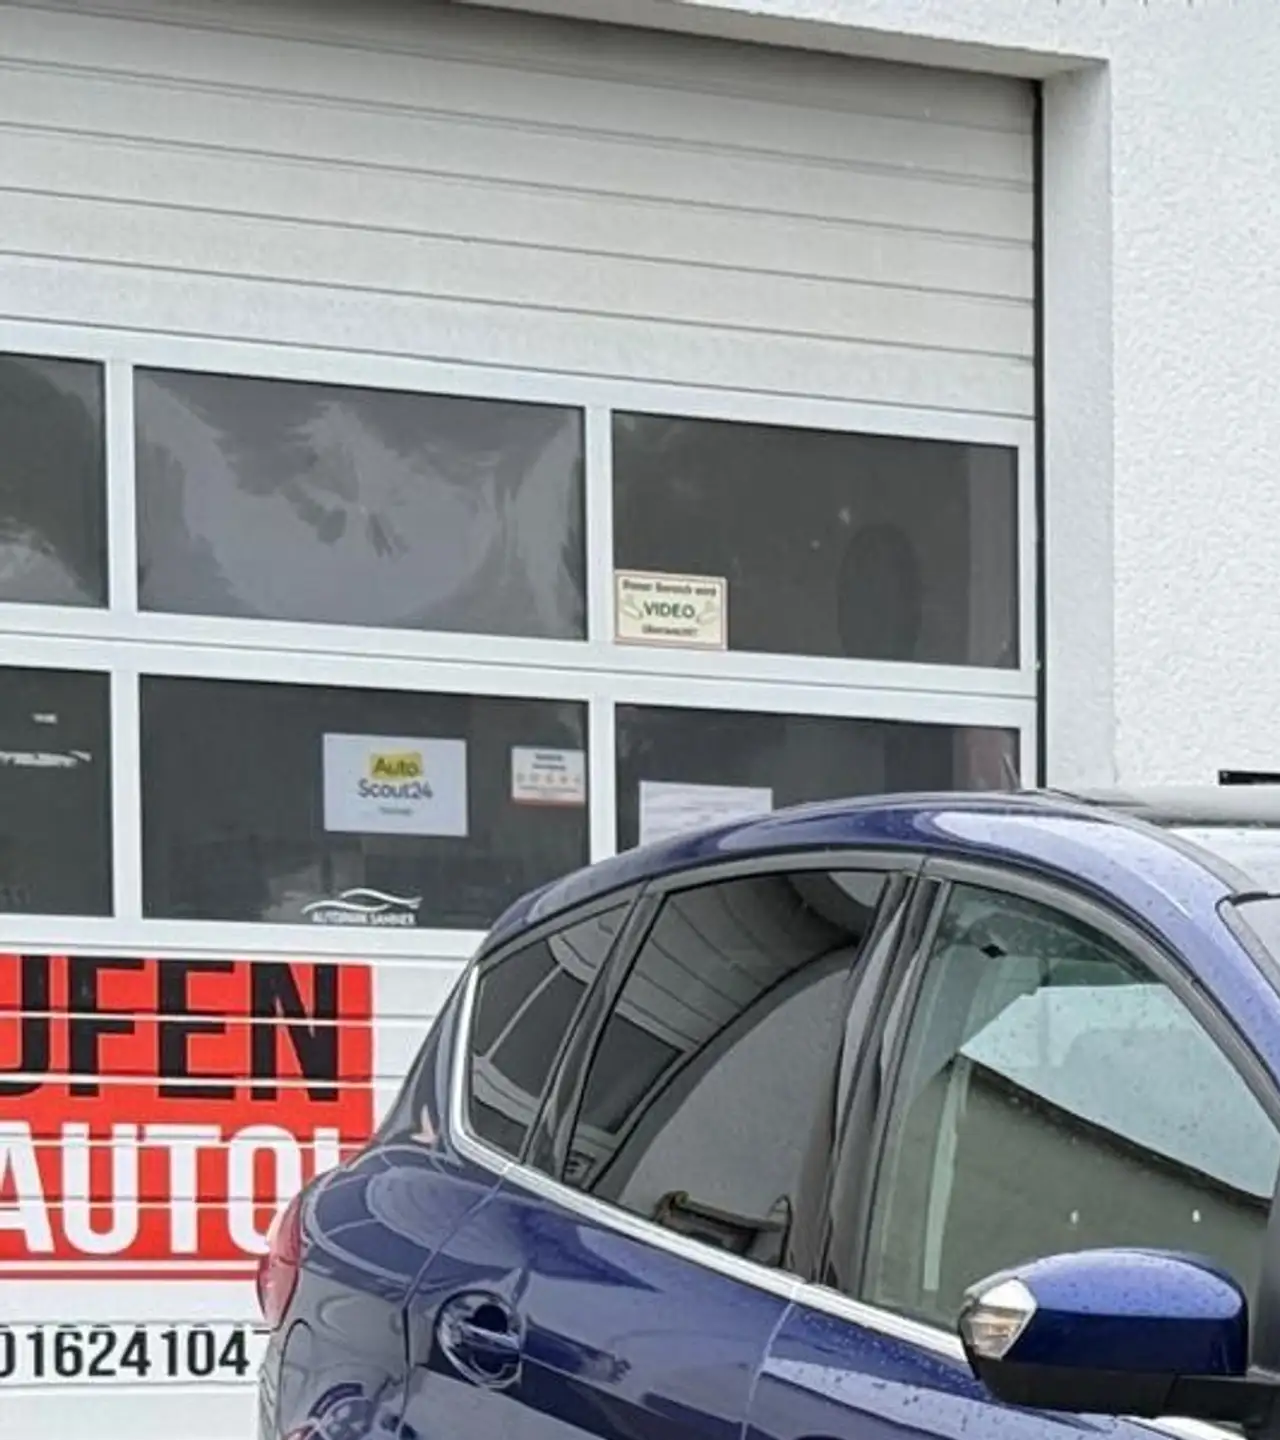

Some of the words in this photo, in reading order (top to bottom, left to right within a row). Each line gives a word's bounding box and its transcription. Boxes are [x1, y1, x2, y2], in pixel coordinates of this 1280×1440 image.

[643, 600, 695, 618] VIDEO
[373, 757, 419, 777] Auto
[357, 778, 433, 799] Scout24
